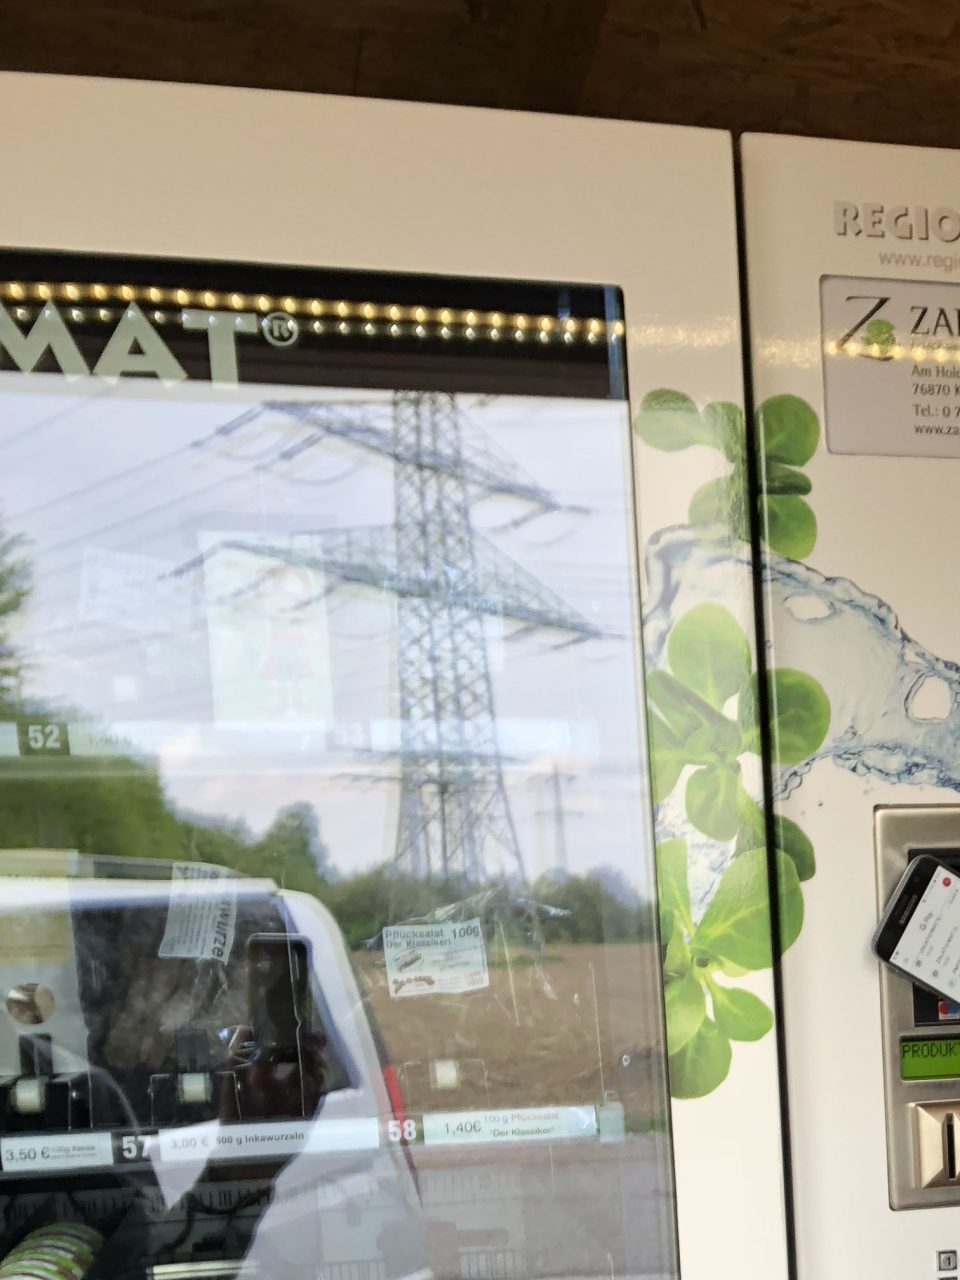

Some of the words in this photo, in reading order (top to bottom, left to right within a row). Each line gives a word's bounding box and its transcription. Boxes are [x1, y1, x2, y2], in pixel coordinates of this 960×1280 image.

[911, 364, 931, 378] Am
[912, 383, 951, 396] 76870
[912, 404, 939, 418] Tel.:
[942, 406, 950, 418] 0
[28, 724, 60, 749] 52
[452, 925, 480, 939] 100g
[388, 1119, 417, 1142] 58
[444, 1121, 481, 1136] 1,40€
[122, 1135, 150, 1160] 57
